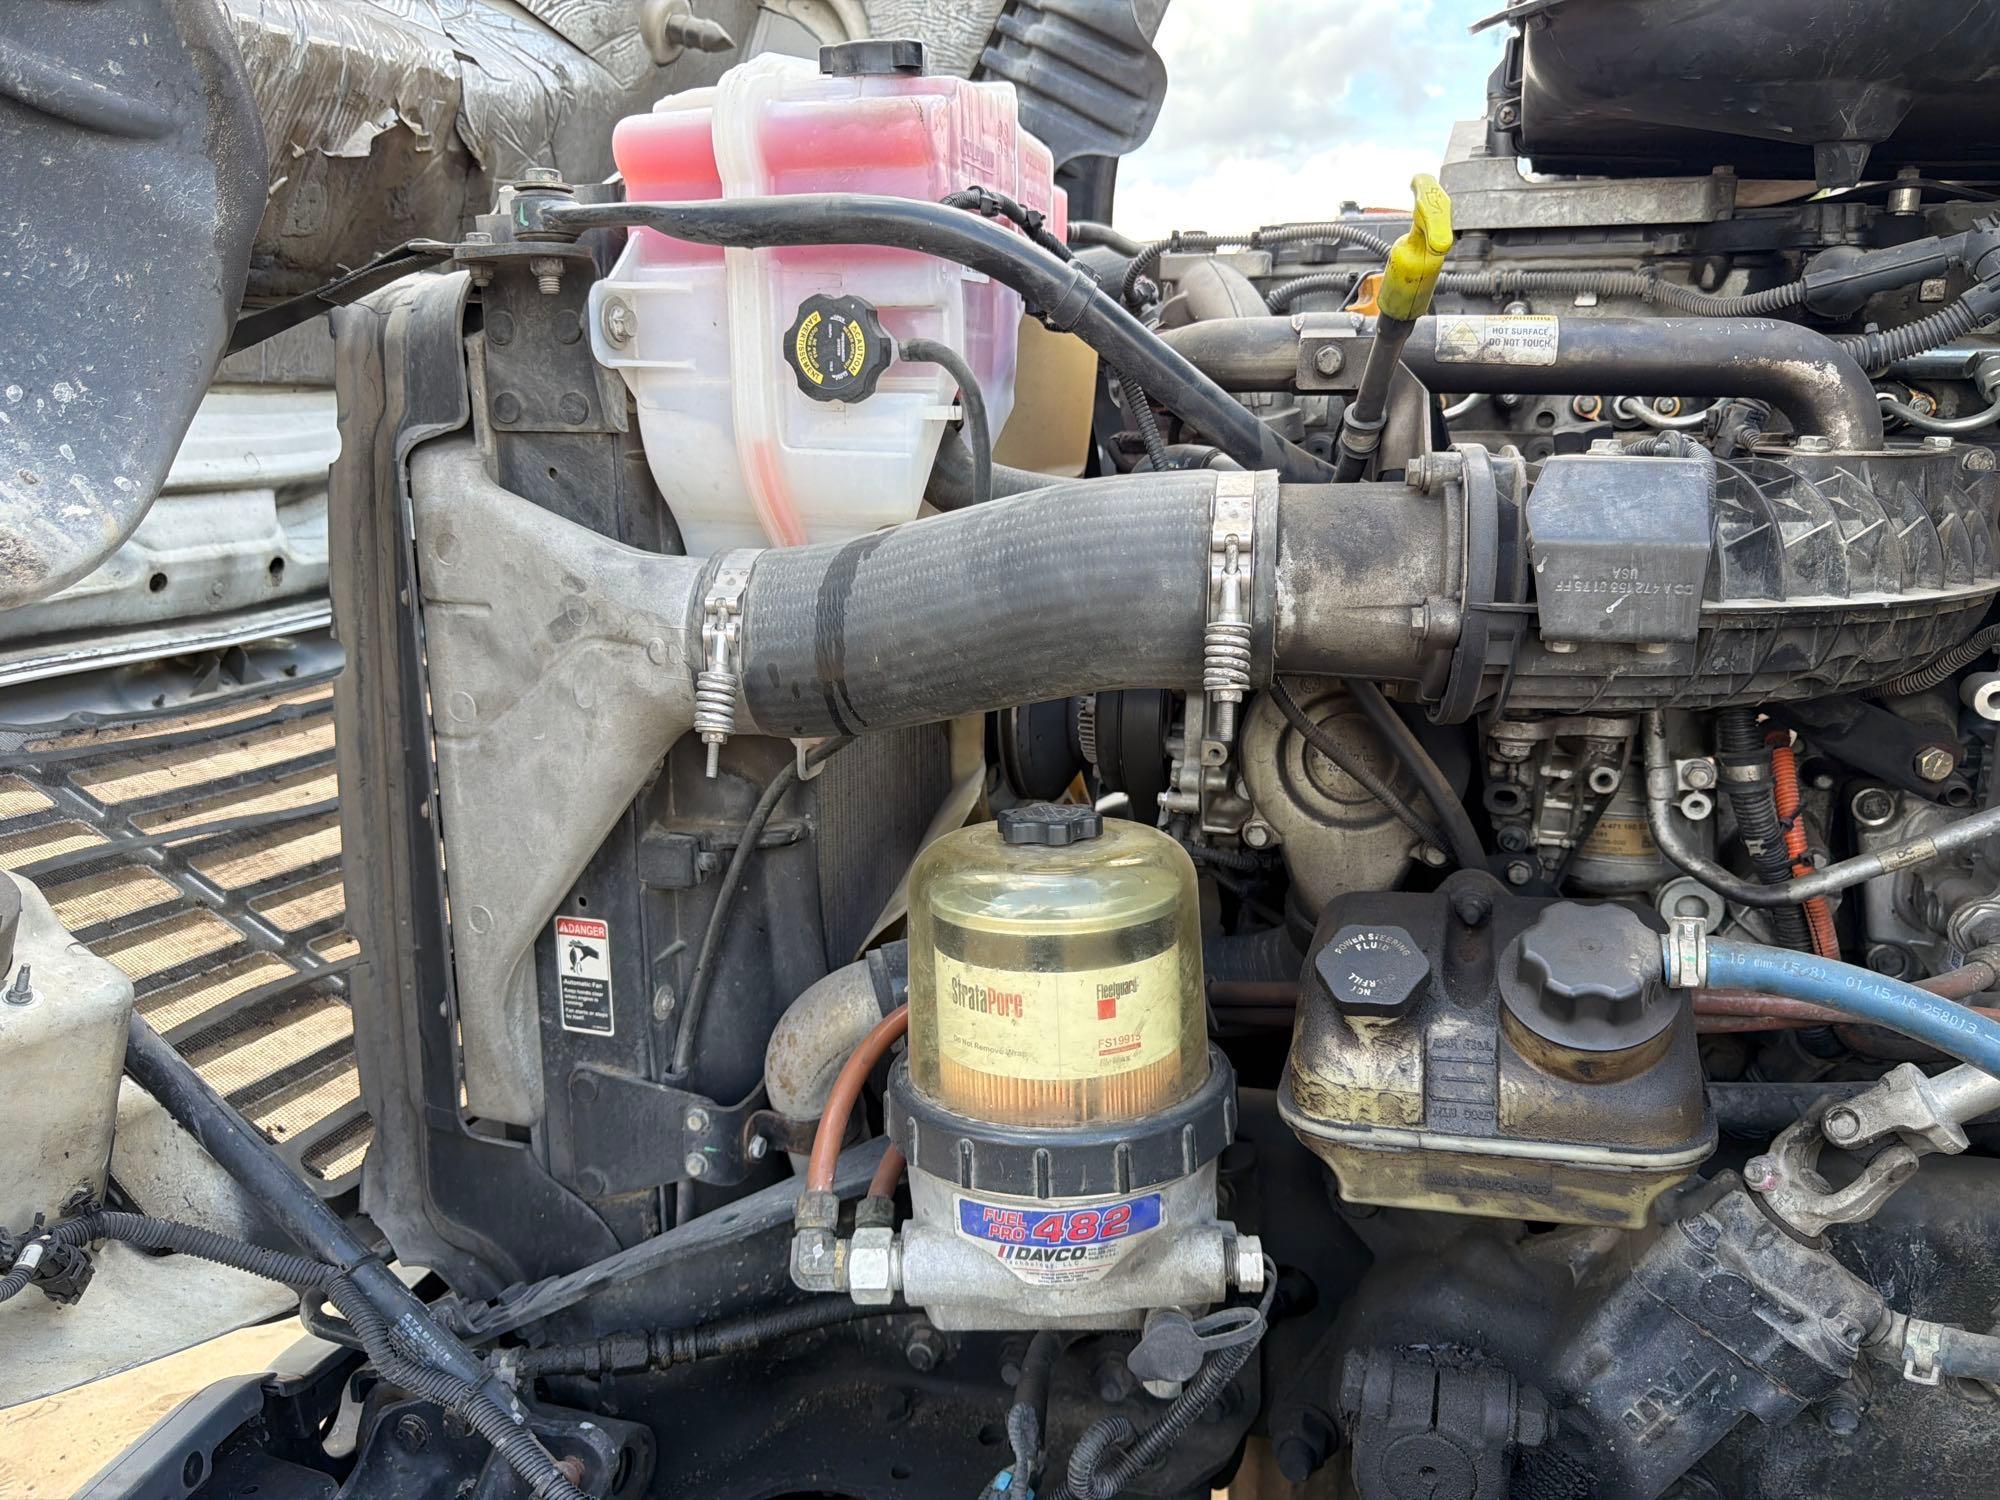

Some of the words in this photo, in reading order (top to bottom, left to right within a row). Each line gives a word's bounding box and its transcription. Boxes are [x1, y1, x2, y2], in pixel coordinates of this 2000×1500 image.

[1492, 327, 1509, 335] HOT
[1511, 327, 1549, 336] SURFACE
[798, 319, 821, 380] AVERTISSEMENT
[850, 331, 864, 373] CAUTION
[1488, 338, 1500, 346] DO
[1503, 338, 1520, 347] NOT
[1612, 567, 1639, 580] USA
[568, 923, 605, 937] DANGER
[1334, 933, 1365, 955] POWER
[1367, 932, 1411, 957] STEERING
[1355, 941, 1389, 951] FLUID
[951, 977, 1023, 1019] StrataPore
[1096, 978, 1138, 1000] Fleetguard
[1730, 952, 1745, 965] 16
[1754, 957, 1773, 969] mm
[1845, 976, 1917, 1010] 01/15/16
[1921, 1003, 1978, 1035] 258013
[953, 1033, 962, 1044] Do
[962, 1038, 974, 1048] Not
[974, 1041, 1005, 1056] Remove
[983, 1207, 1028, 1228] FUEL
[1031, 1204, 1131, 1244] 482
[988, 1223, 1026, 1241] PRO
[1015, 1246, 1087, 1262] DAVCO
